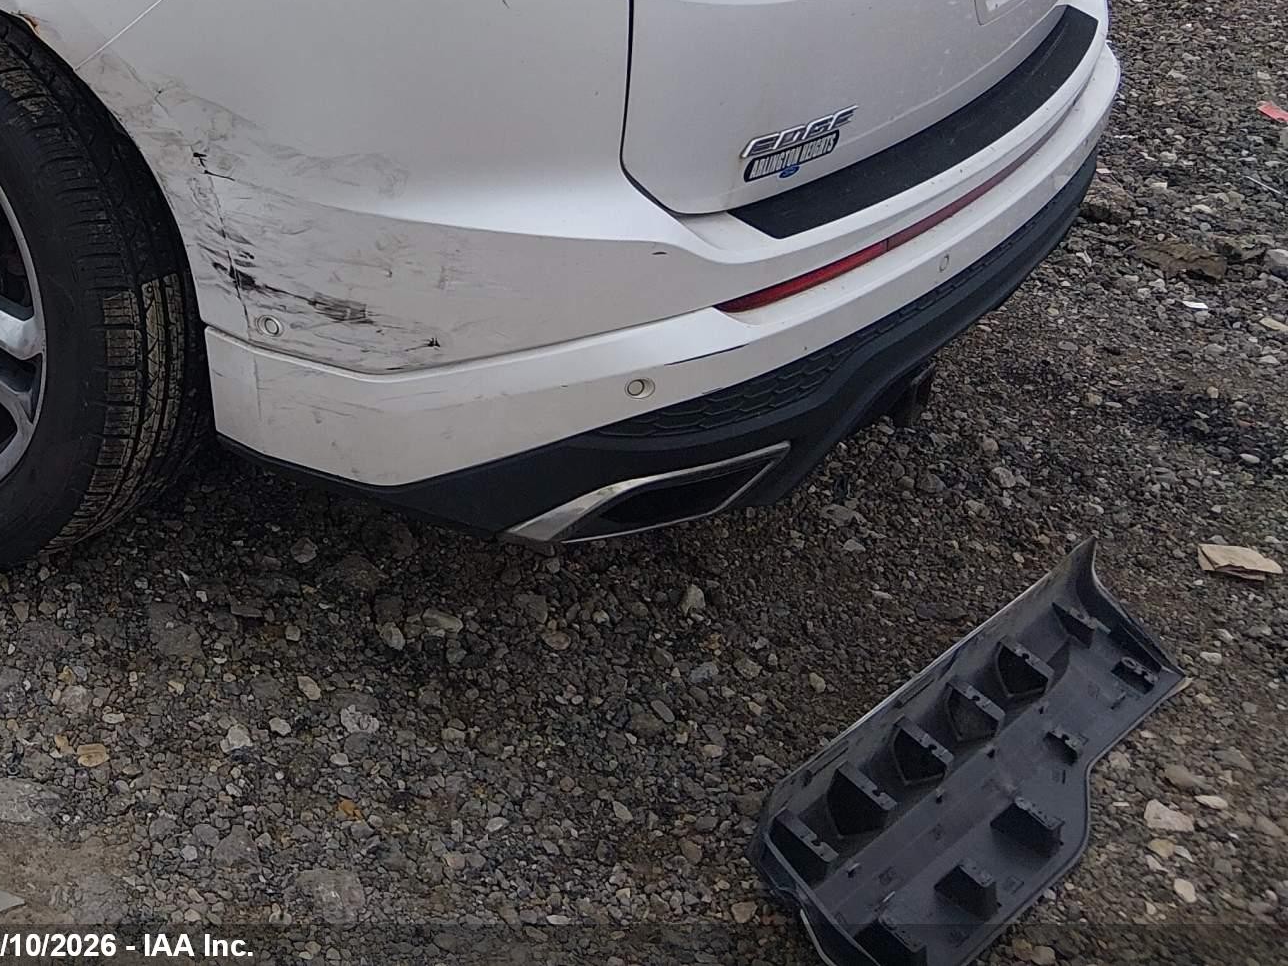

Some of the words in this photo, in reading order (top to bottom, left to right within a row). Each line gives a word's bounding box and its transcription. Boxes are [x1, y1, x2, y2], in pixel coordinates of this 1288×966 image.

[740, 105, 859, 158] EDGE
[748, 145, 801, 179] ARLINGTON
[798, 132, 837, 161] HEIGHTS
